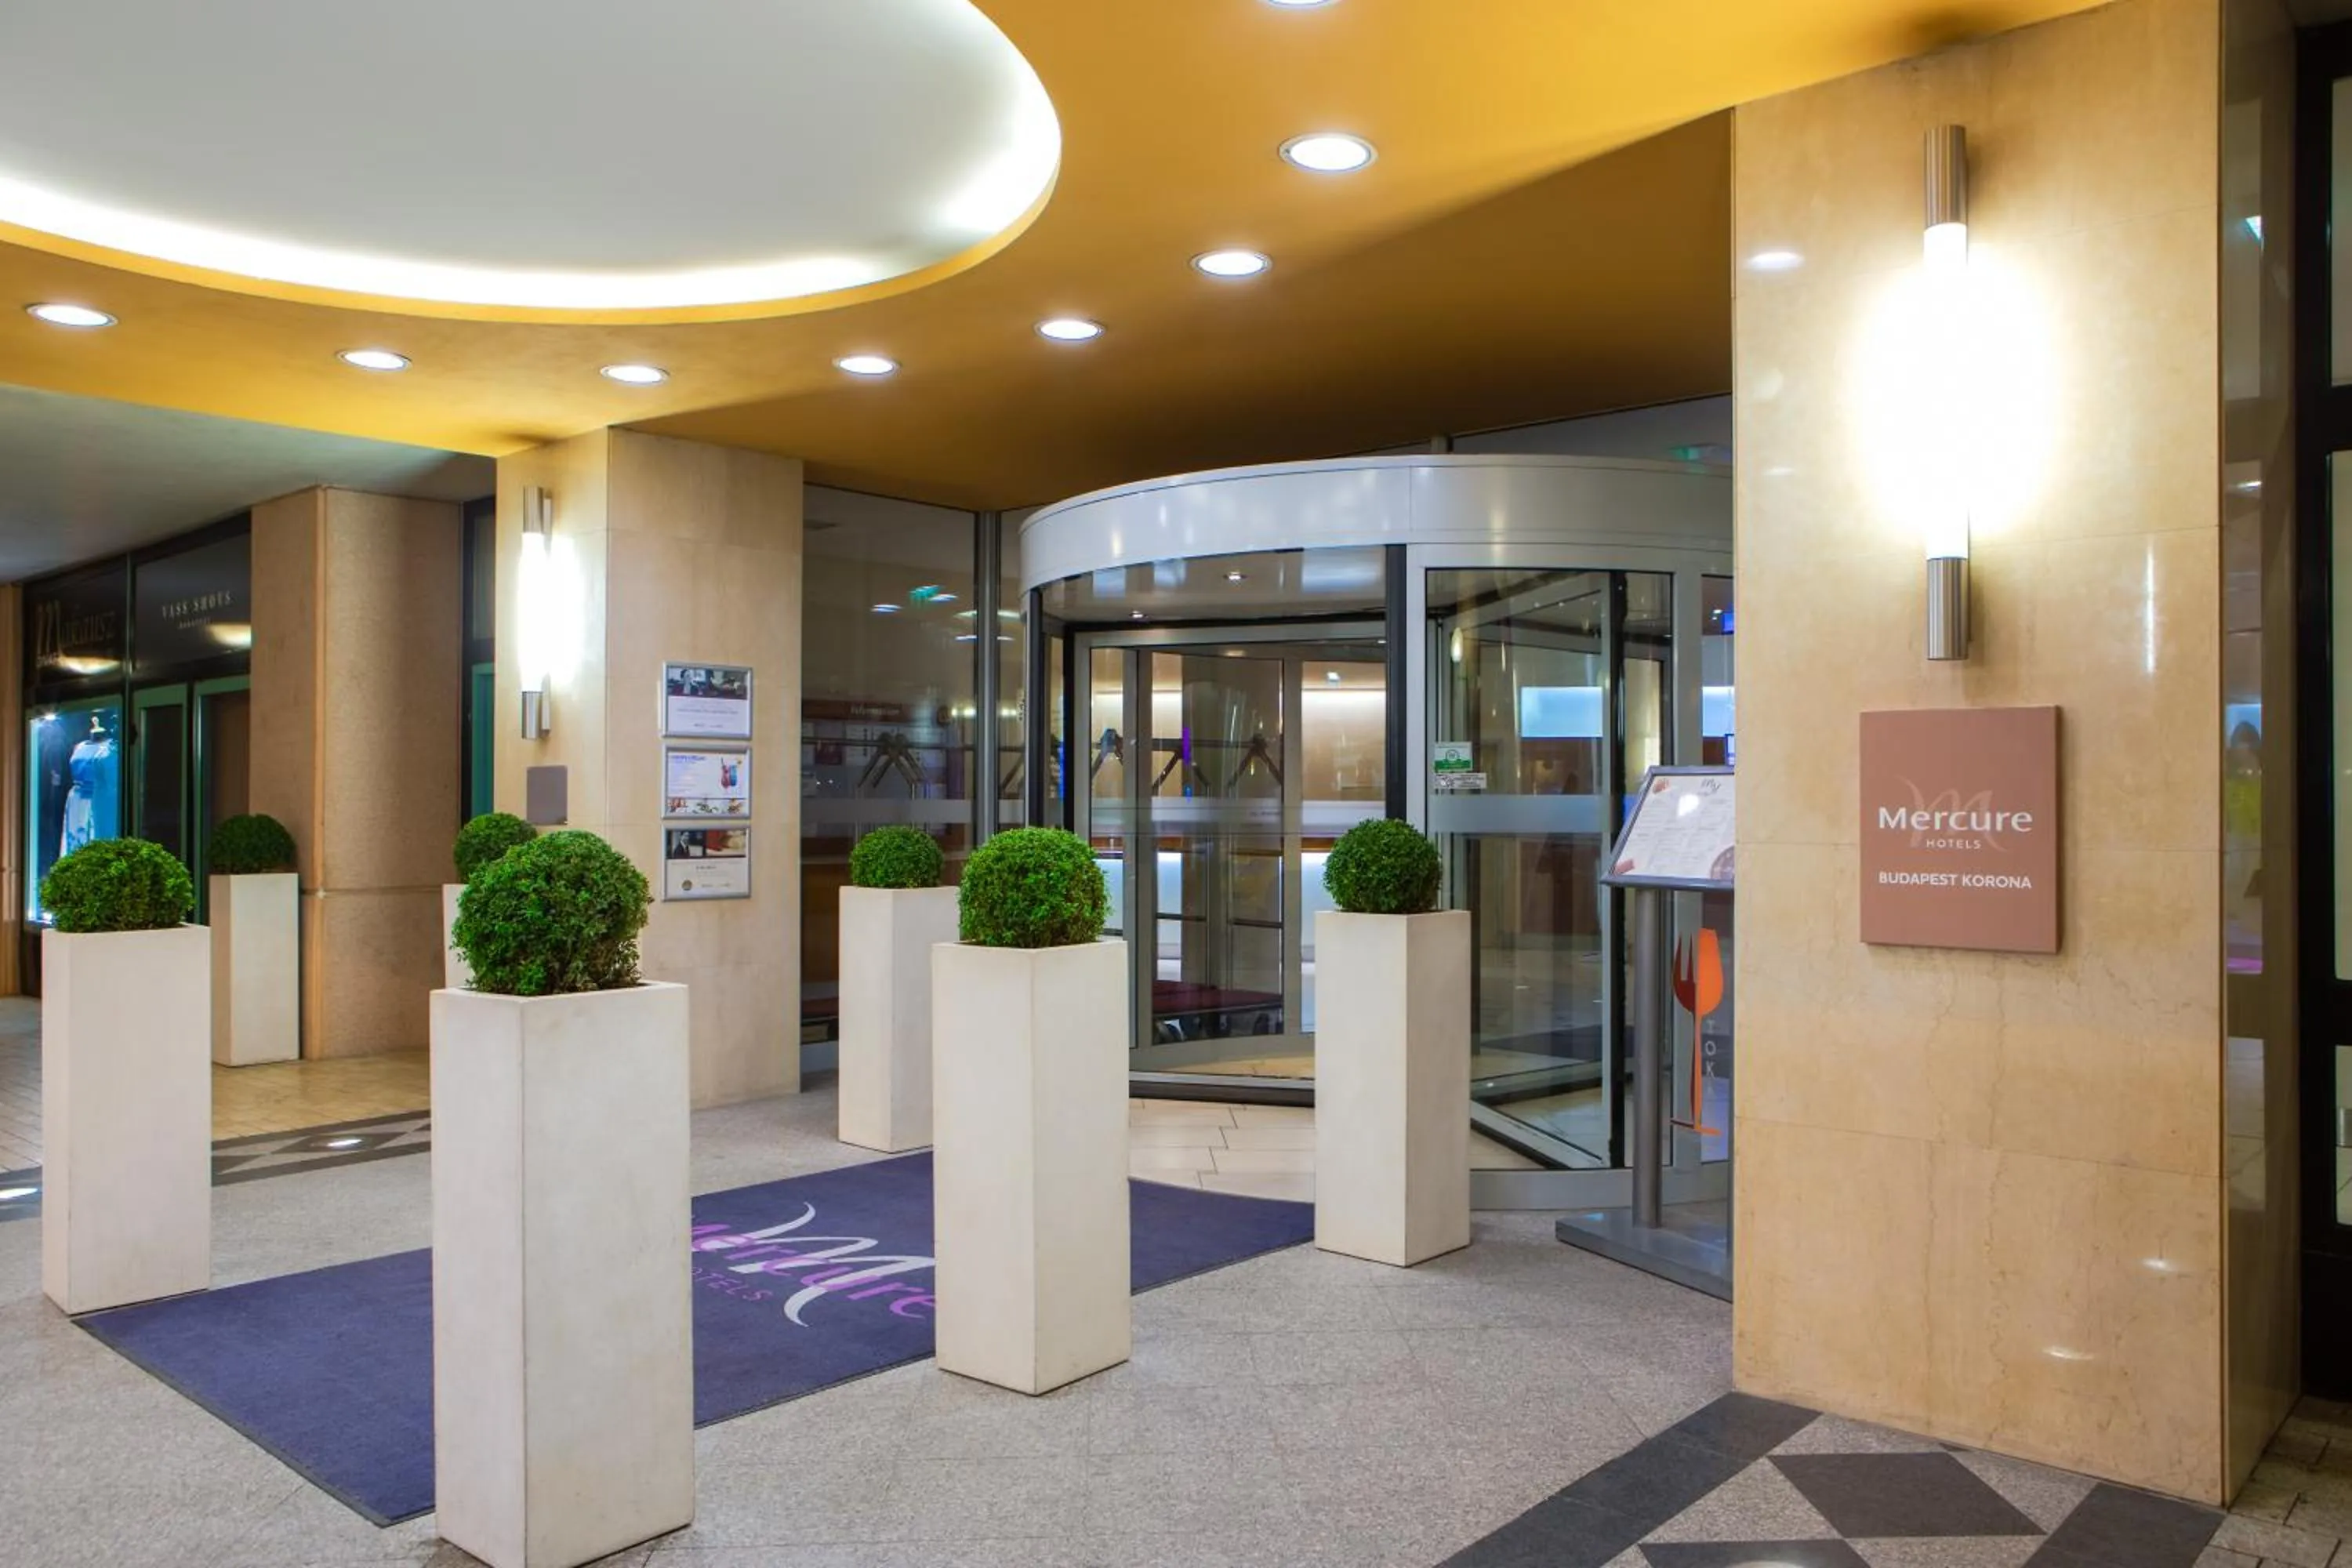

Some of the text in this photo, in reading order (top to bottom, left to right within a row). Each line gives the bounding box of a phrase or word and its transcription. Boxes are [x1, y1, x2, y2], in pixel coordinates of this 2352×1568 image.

[1878, 806, 2033, 833] Mercure
[1926, 838, 1982, 850] HOTELS
[1878, 871, 2032, 889] BUDAPEST KORONA
[691, 1223, 935, 1321] ercure
